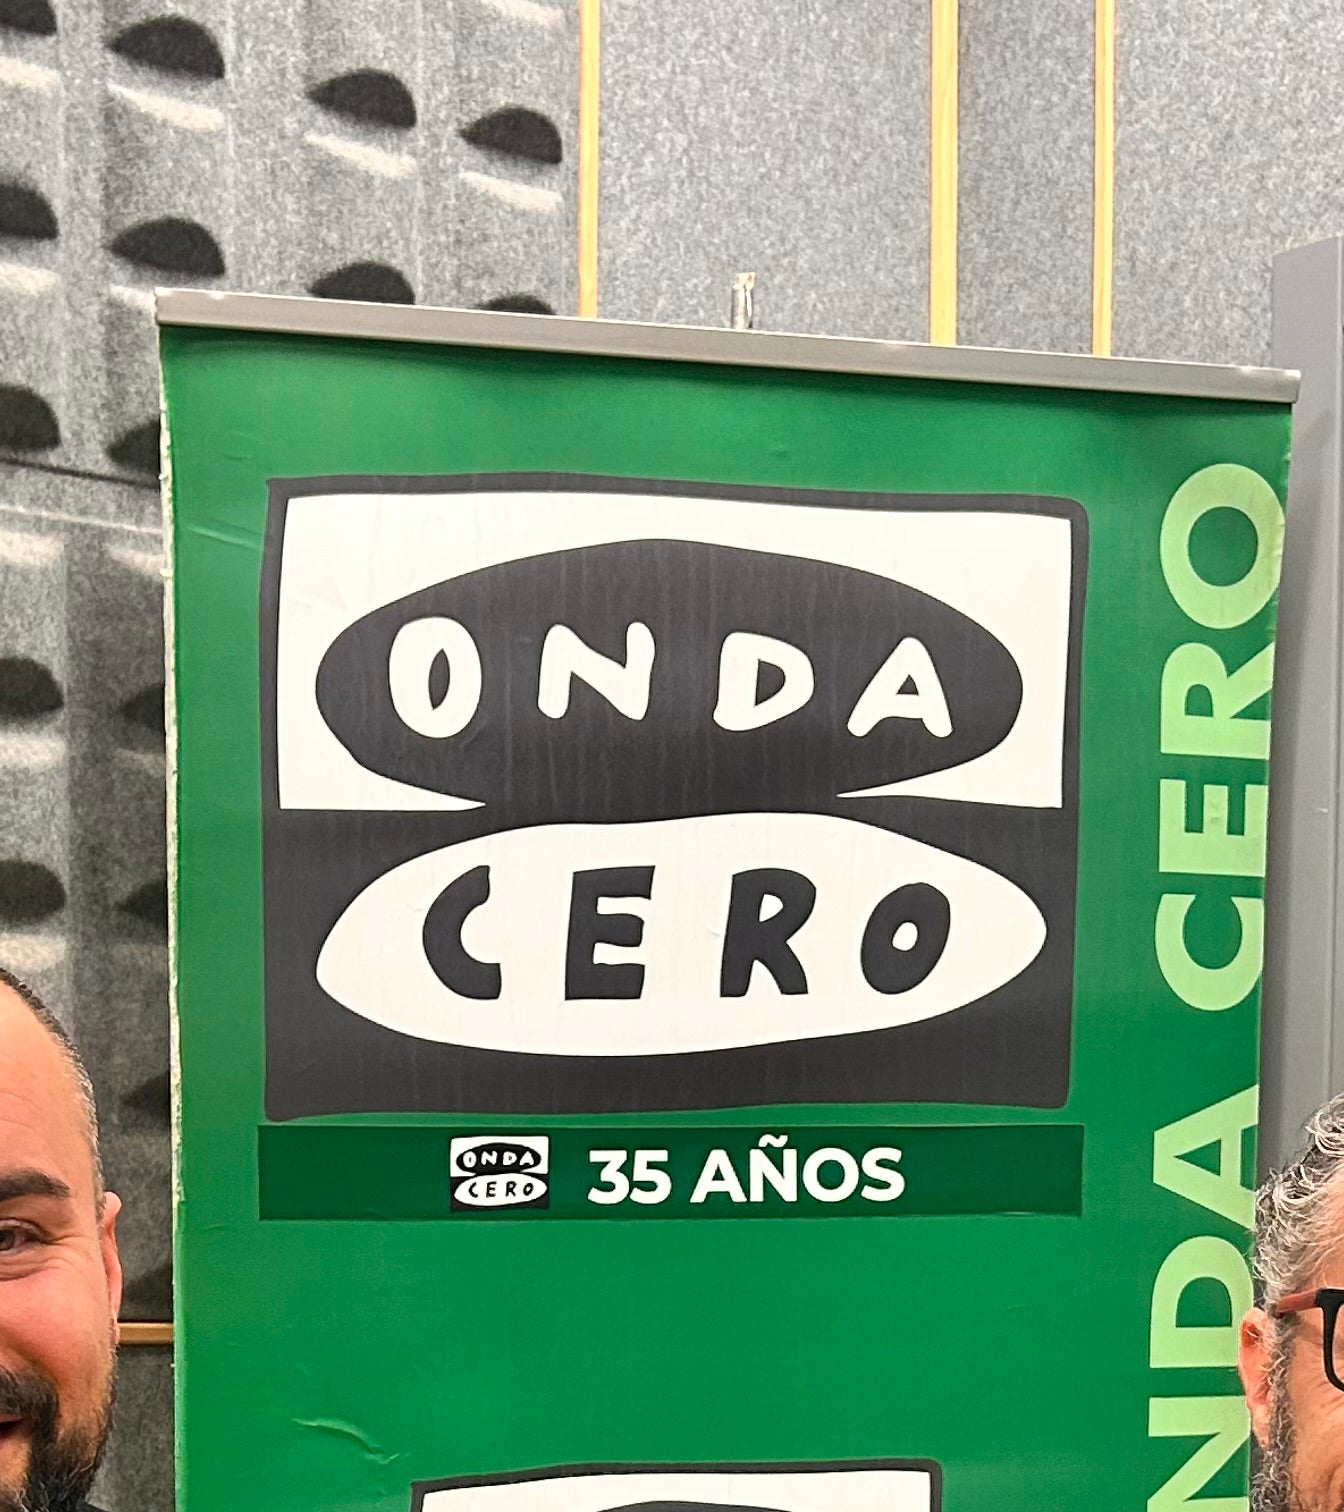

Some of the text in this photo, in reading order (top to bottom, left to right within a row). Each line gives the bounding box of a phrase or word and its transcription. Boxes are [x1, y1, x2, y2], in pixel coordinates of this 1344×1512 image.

[388, 616, 953, 738] ONDA
[1155, 463, 1286, 1011] CERO
[422, 865, 951, 999] CERO
[462, 1150, 535, 1168] ONDA
[468, 1181, 534, 1198] CERO
[587, 1133, 906, 1205] 35 AÑOS
